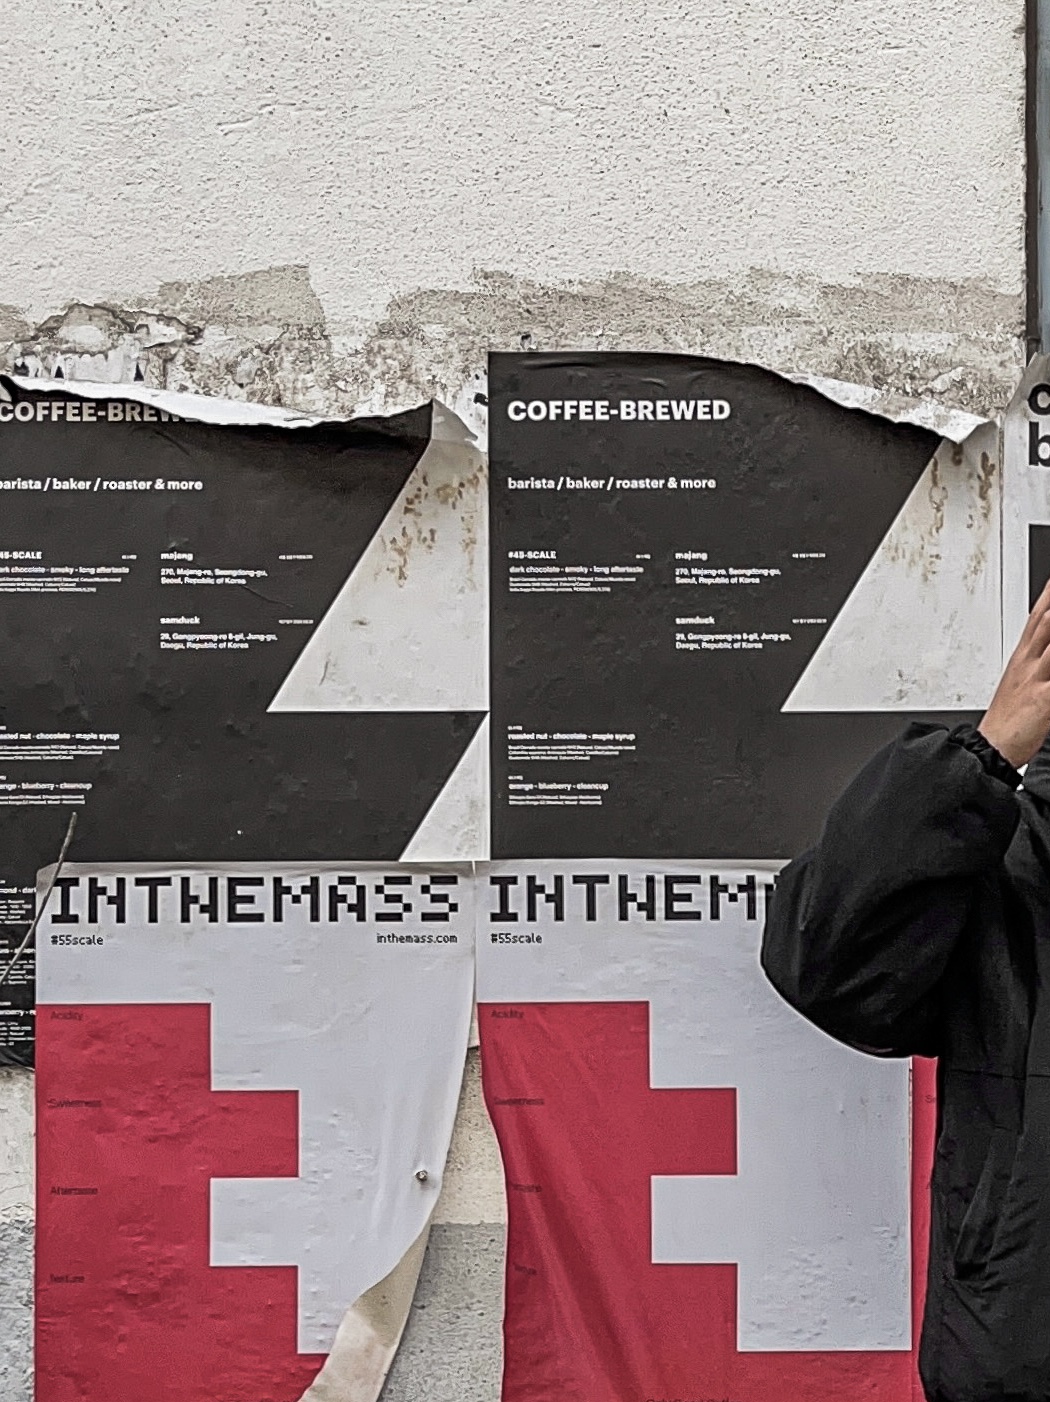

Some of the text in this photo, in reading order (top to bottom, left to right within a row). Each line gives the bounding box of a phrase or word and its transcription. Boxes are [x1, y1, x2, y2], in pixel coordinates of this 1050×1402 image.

[0, 402, 200, 422] COFFEE-BREW
[507, 400, 731, 421] COFFEE-BREWED
[52, 477, 92, 490] baker
[103, 479, 152, 490] roaster
[154, 479, 165, 490] &
[167, 481, 203, 490] more
[508, 477, 554, 490] barista
[565, 477, 605, 490] baker
[616, 479, 665, 490] roaster
[668, 478, 678, 489] &
[680, 481, 716, 490] more
[0, 551, 43, 560] 45-SCALE
[161, 552, 193, 562] majang
[675, 551, 708, 561] majang
[216, 577, 224, 585] of
[730, 576, 738, 585] of
[160, 615, 200, 625] samduck
[675, 616, 715, 625] samduck
[218, 641, 227, 650] of
[733, 641, 741, 650] of
[51, 933, 458, 946] #55scale inthemass.com
[490, 932, 542, 944] #55scale
